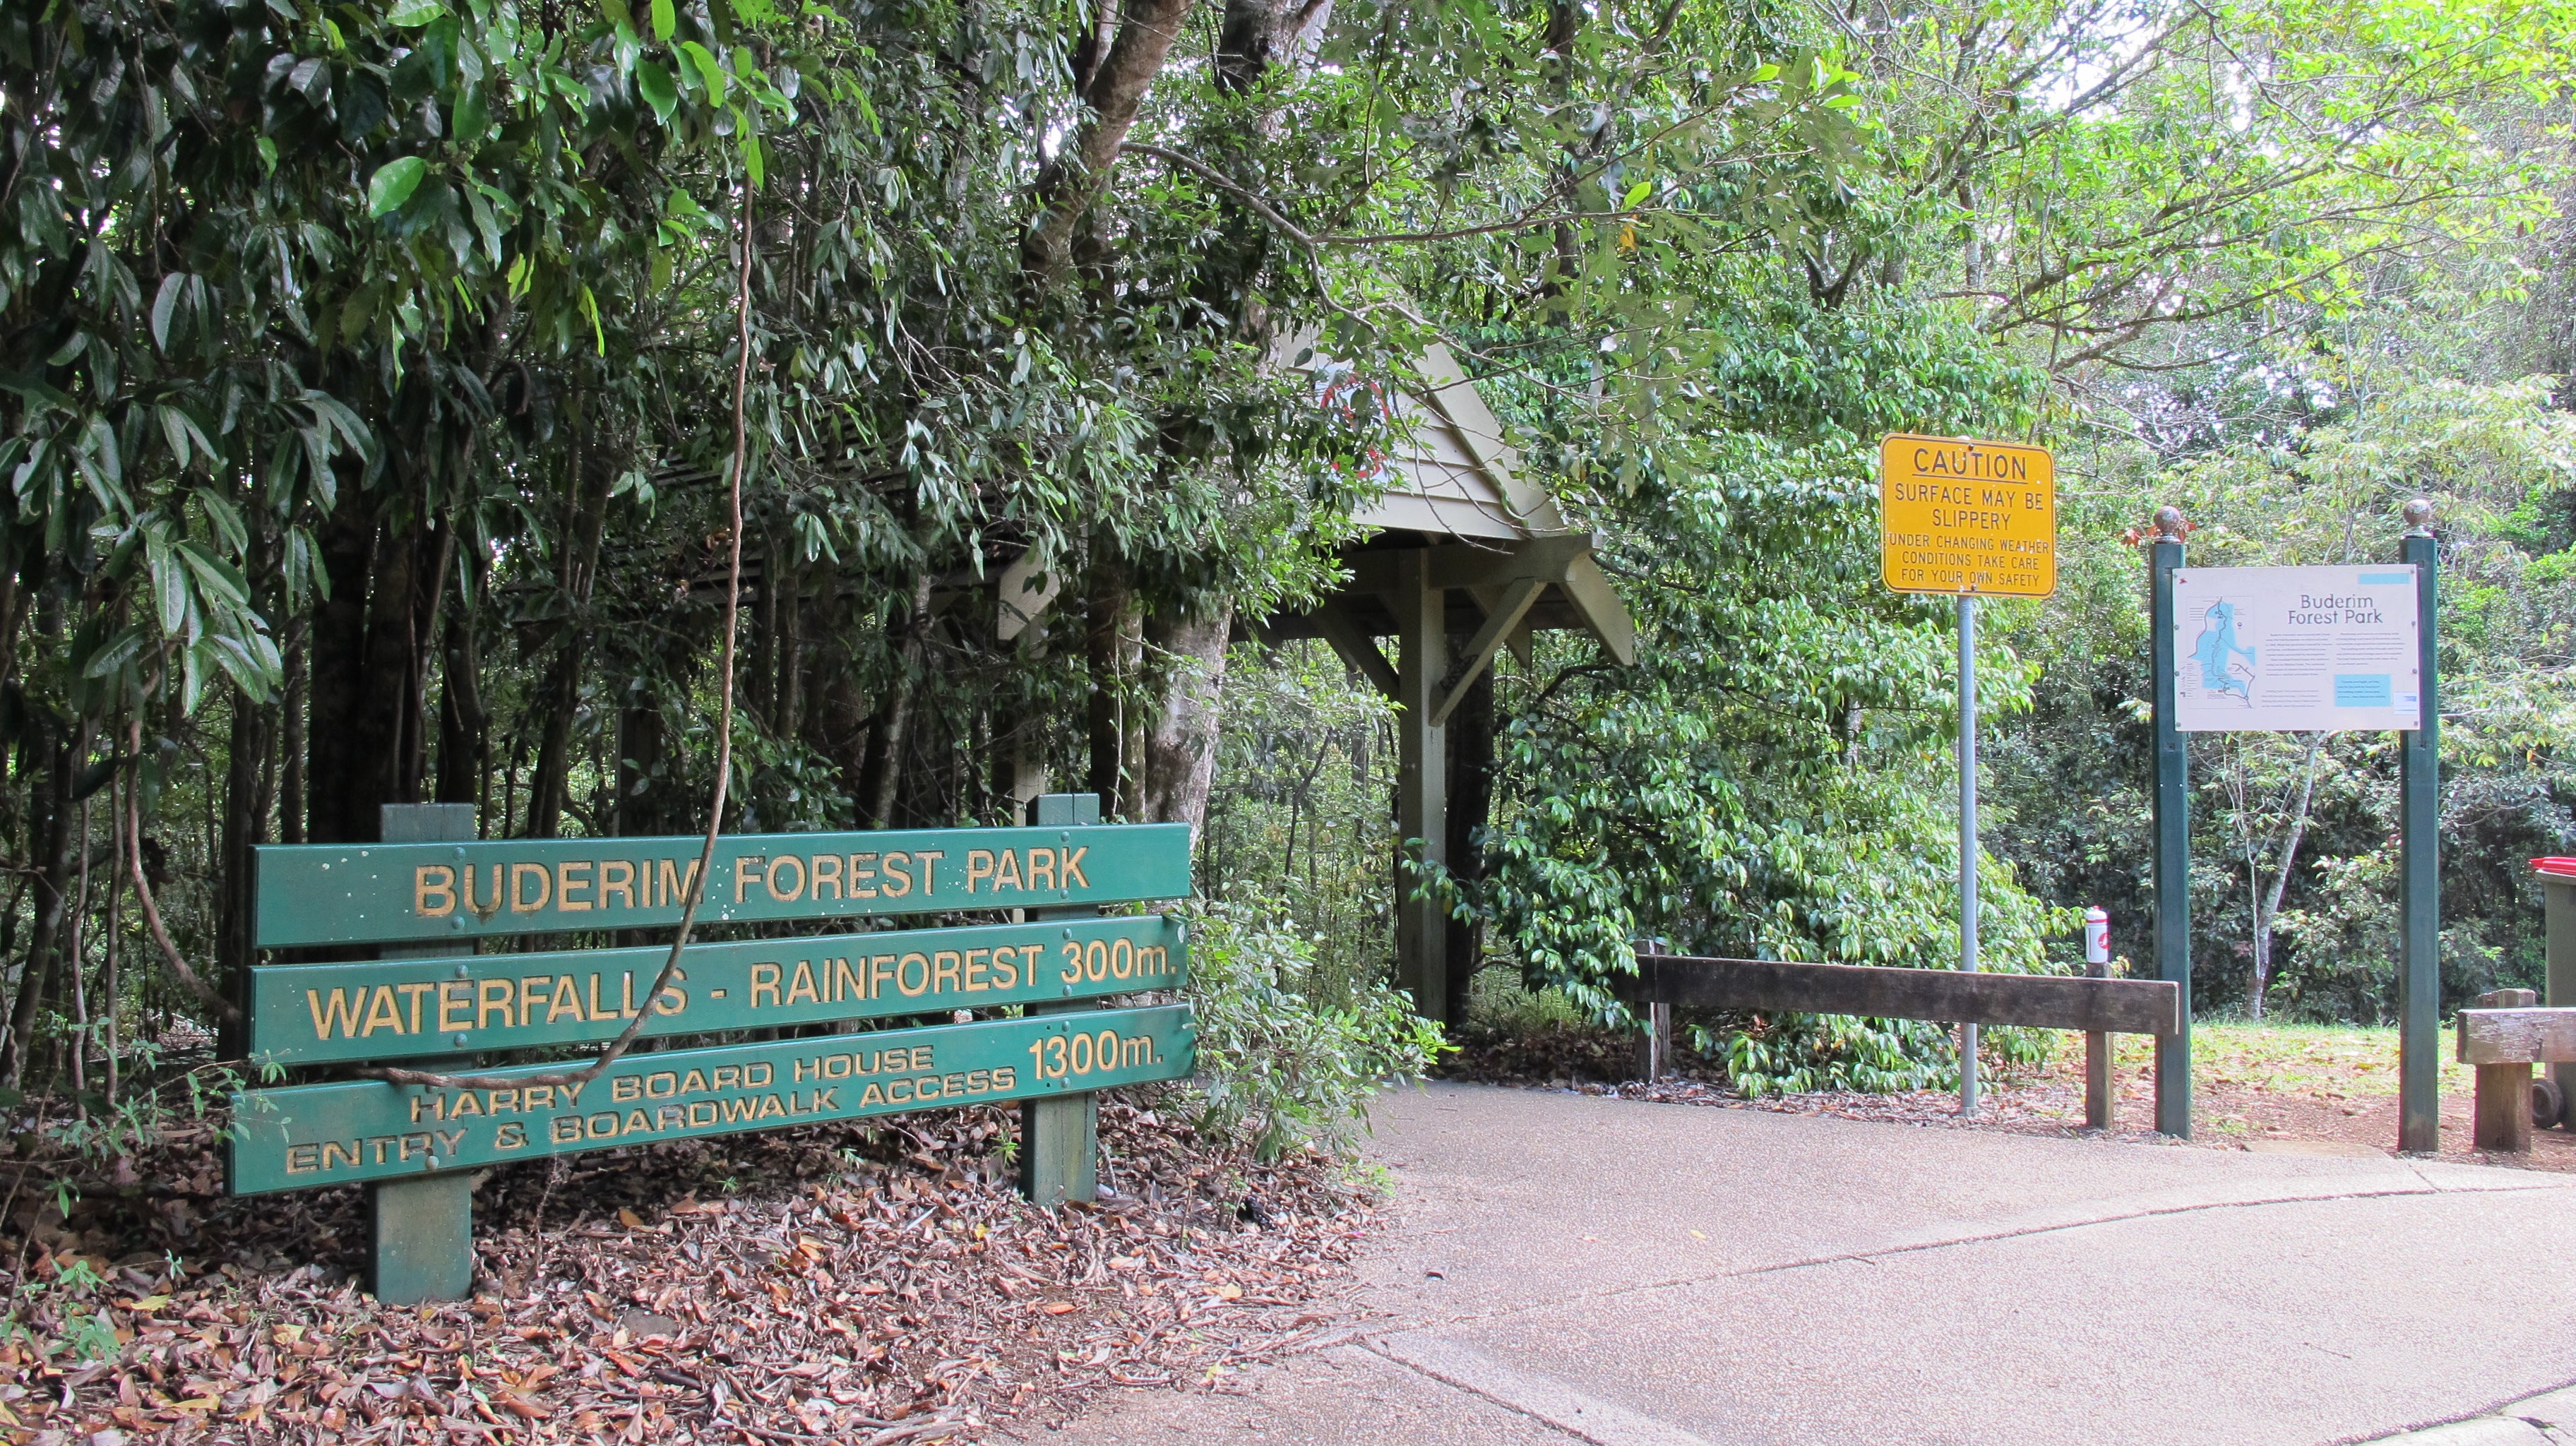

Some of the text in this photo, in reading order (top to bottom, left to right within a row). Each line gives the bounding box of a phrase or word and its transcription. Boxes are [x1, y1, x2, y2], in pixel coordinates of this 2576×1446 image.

[1914, 448, 2026, 480] CAUTION
[1895, 483, 2044, 510] SURFACE MAY BE
[1932, 508, 2011, 530] SLIPPERY
[1889, 533, 2049, 554] UNDER CHANGING WEATHER
[1902, 551, 2039, 570] CONDITIONS TAKE CARE
[1901, 568, 2040, 587] FOR YOUR OWN SAFETY
[2300, 593, 2373, 609] Buderim
[2288, 609, 2383, 625] Forest Park
[414, 846, 1090, 917] BUDERIM FOREST PARK
[306, 969, 688, 1040] WATERFALLS
[749, 944, 1045, 1008] RAINFOREST
[1061, 937, 1179, 984] 300m.
[410, 1029, 1164, 1123] HARRY BOARD HOUSE 1300m.
[286, 1065, 1016, 1174] ENTRY & BOARDWALK ACCESS
